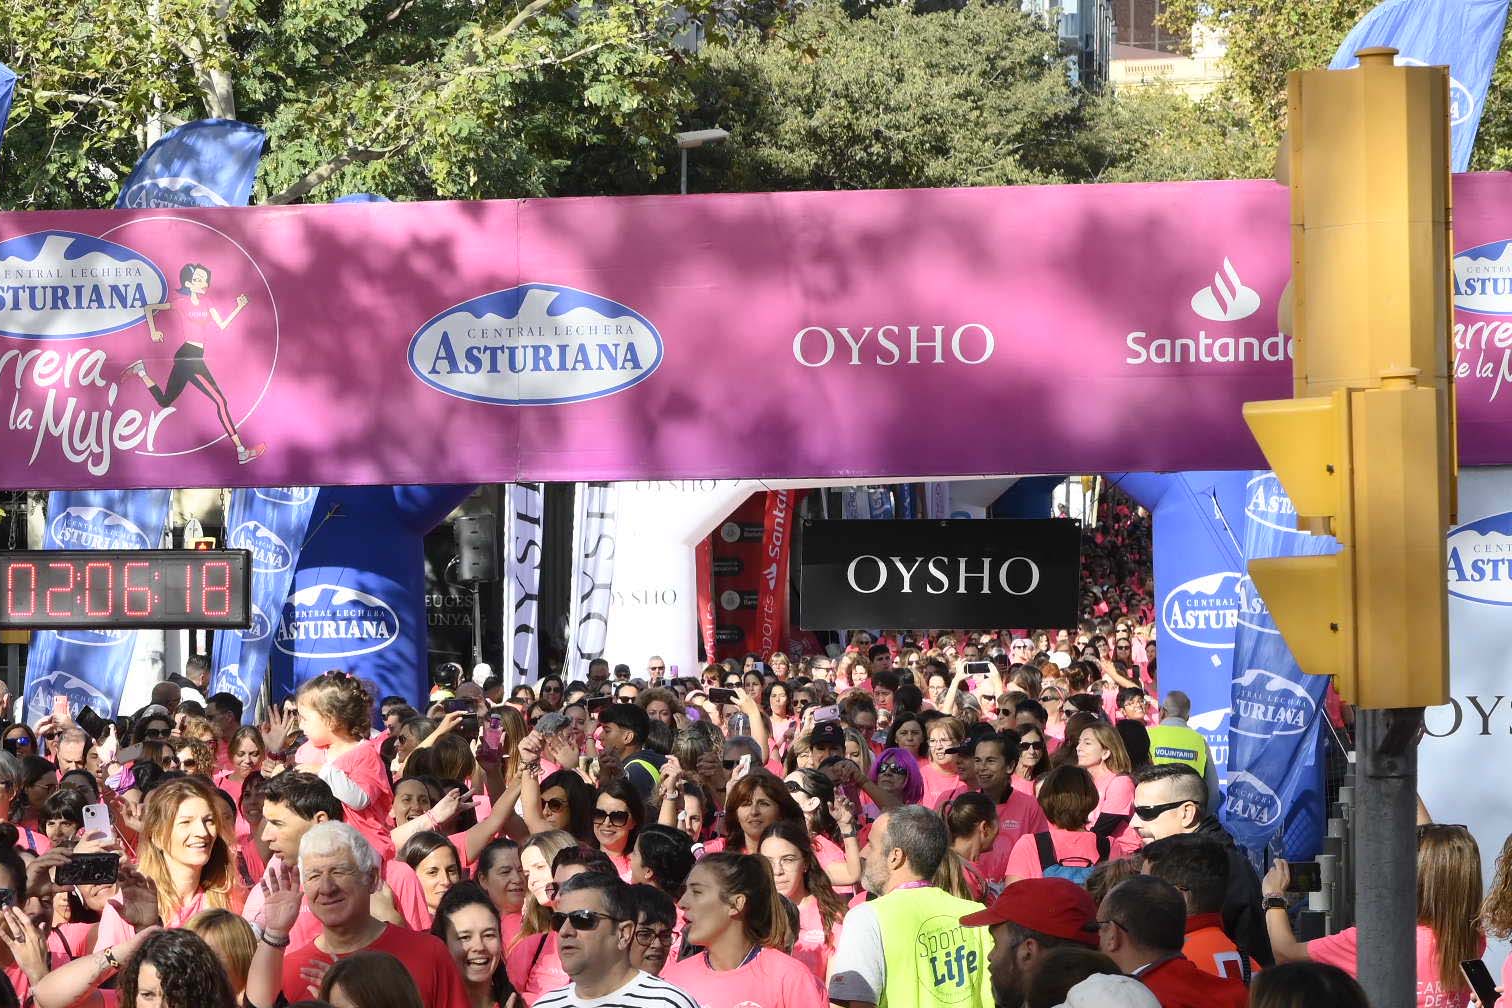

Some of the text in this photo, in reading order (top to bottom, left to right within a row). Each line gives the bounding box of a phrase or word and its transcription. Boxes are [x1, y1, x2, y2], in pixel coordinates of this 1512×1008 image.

[70, 266, 142, 279] LECHERA
[467, 323, 635, 338] CENTRAL LECHERA
[792, 322, 995, 368] OYSHO
[428, 330, 643, 376] ASTURIANA
[8, 398, 34, 430] la
[28, 381, 178, 477] Mujer
[7, 561, 232, 618] 02:06:18
[847, 555, 1041, 597] OYSHO
[289, 609, 332, 618] CENTRAL
[1186, 599, 1236, 607] CENTRAL
[276, 614, 390, 642] ASTURIANA
[918, 925, 967, 958] Sport
[930, 944, 978, 988] Life
